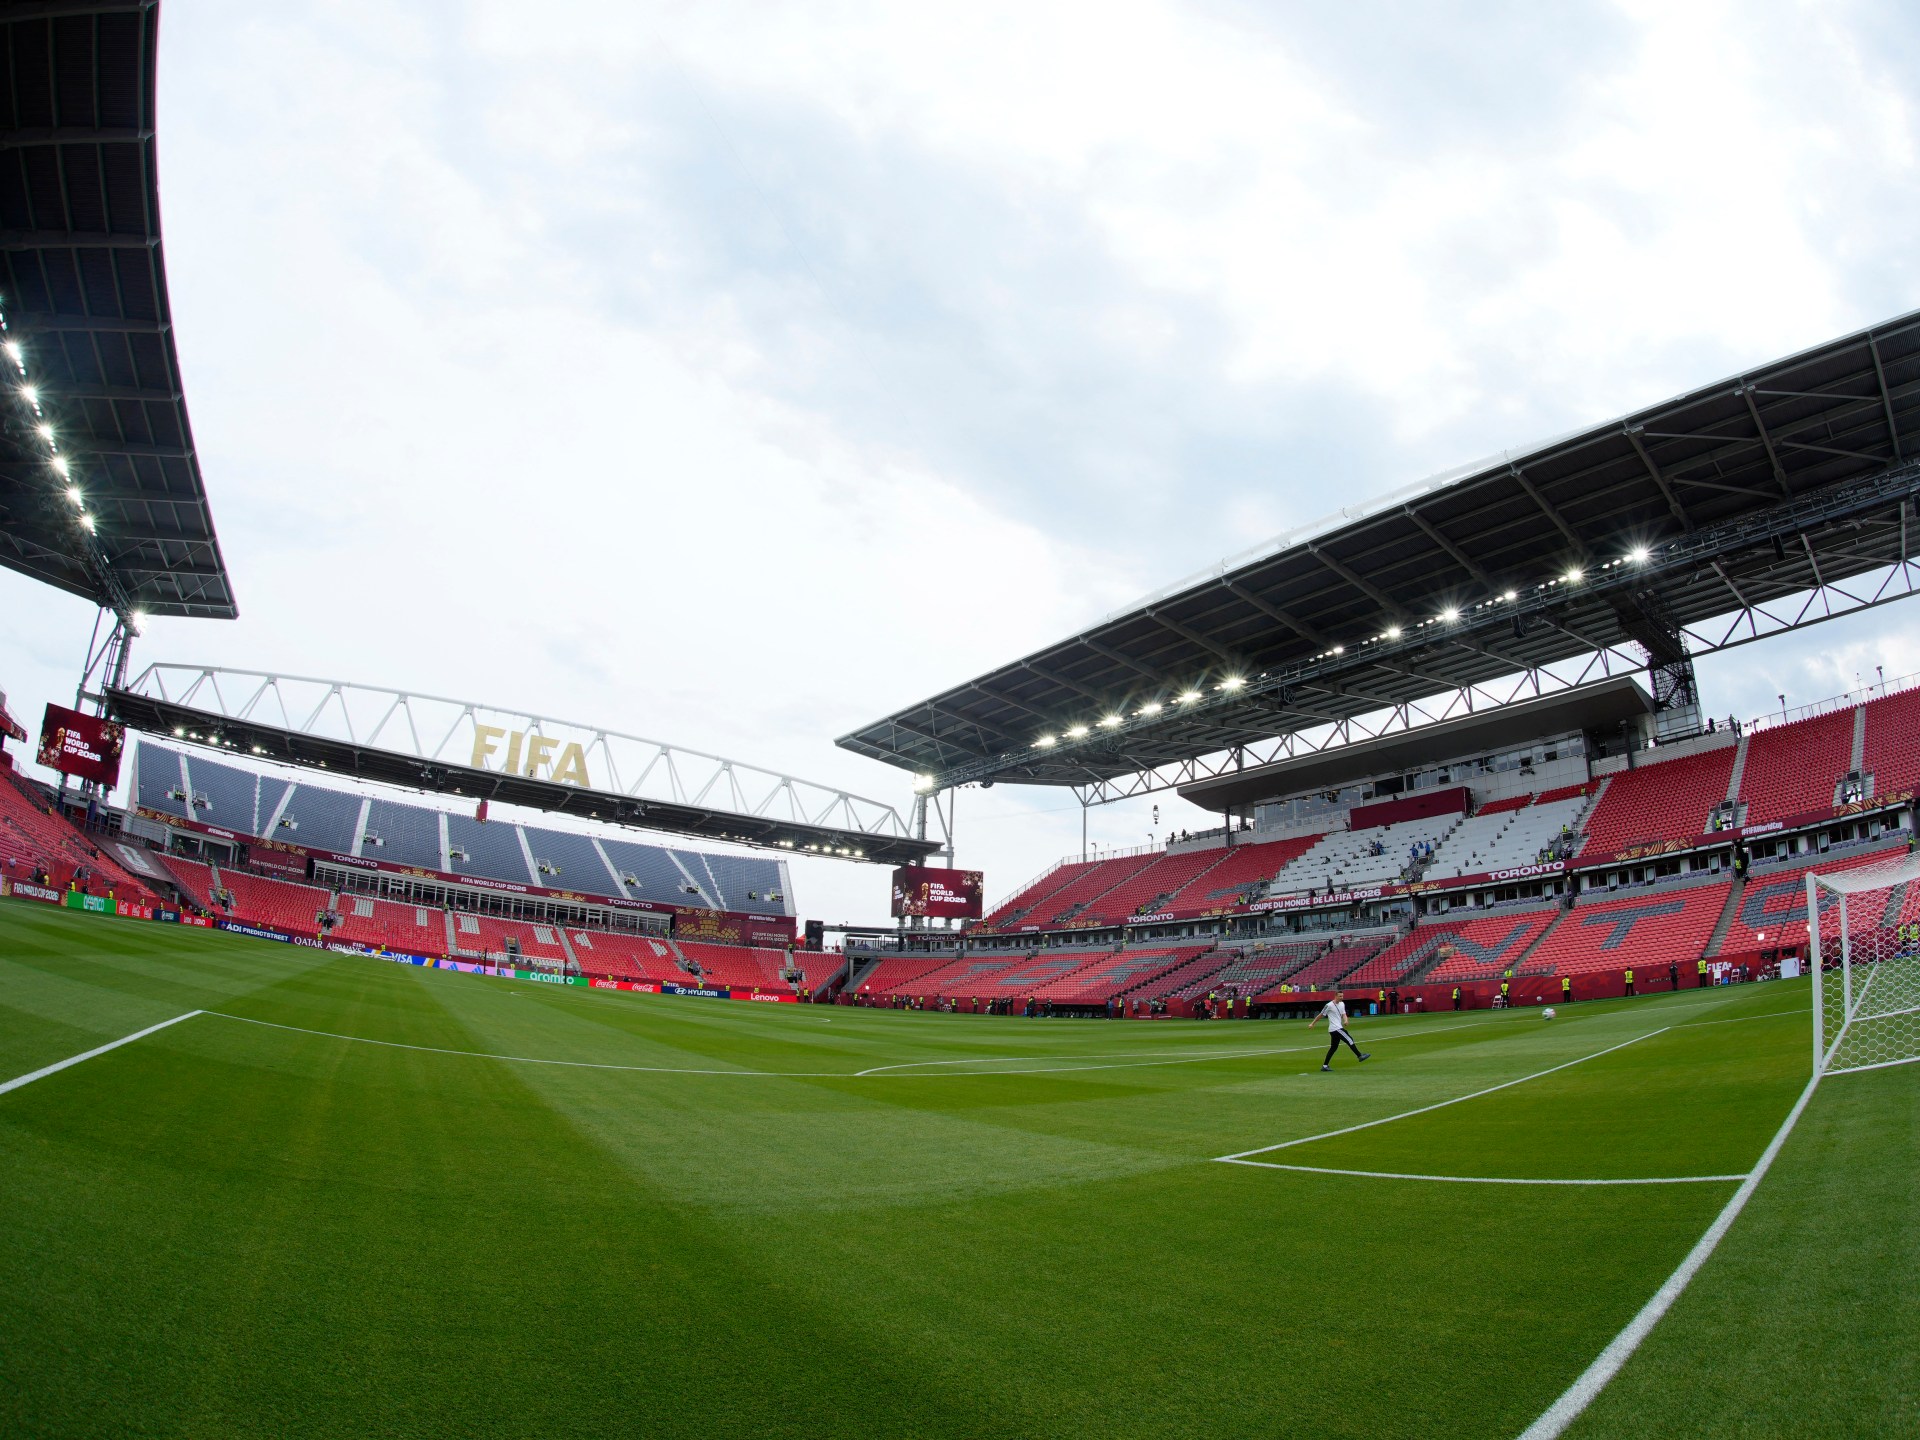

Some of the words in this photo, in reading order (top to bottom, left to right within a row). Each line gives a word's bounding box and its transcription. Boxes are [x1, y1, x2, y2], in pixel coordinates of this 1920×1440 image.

[66, 729, 81, 739] FIFA
[65, 737, 89, 750] WORLD
[63, 745, 78, 754] CUP
[77, 749, 101, 762] 2026
[471, 724, 591, 788] FIFA
[260, 860, 277, 869] WORLD
[332, 854, 378, 868] TORONTO
[1487, 861, 1565, 881] TORONTO
[13, 882, 23, 894] FIFA
[460, 877, 473, 885] FIFA
[473, 879, 495, 888] WORLD
[494, 881, 506, 889] CUP
[506, 883, 527, 892] 2026
[608, 898, 652, 909] TORONTO
[943, 896, 967, 904] 2026
[1249, 901, 1273, 911] COUPE
[1273, 900, 1284, 909] DU
[1284, 897, 1310, 908] MONDE
[1313, 896, 1323, 905] DE
[1323, 894, 1334, 903] LA
[1334, 893, 1351, 902] FIFA
[1353, 889, 1381, 899] 2026
[1127, 912, 1175, 923] TORONTO
[226, 922, 242, 933] ADI
[242, 927, 288, 942] PREDICTSTREET
[294, 936, 323, 949] QATAR
[391, 952, 413, 964] VISA
[1706, 961, 1731, 974] FIFA
[688, 989, 718, 997] HYUNDAI
[750, 993, 779, 1002] Lenovo
